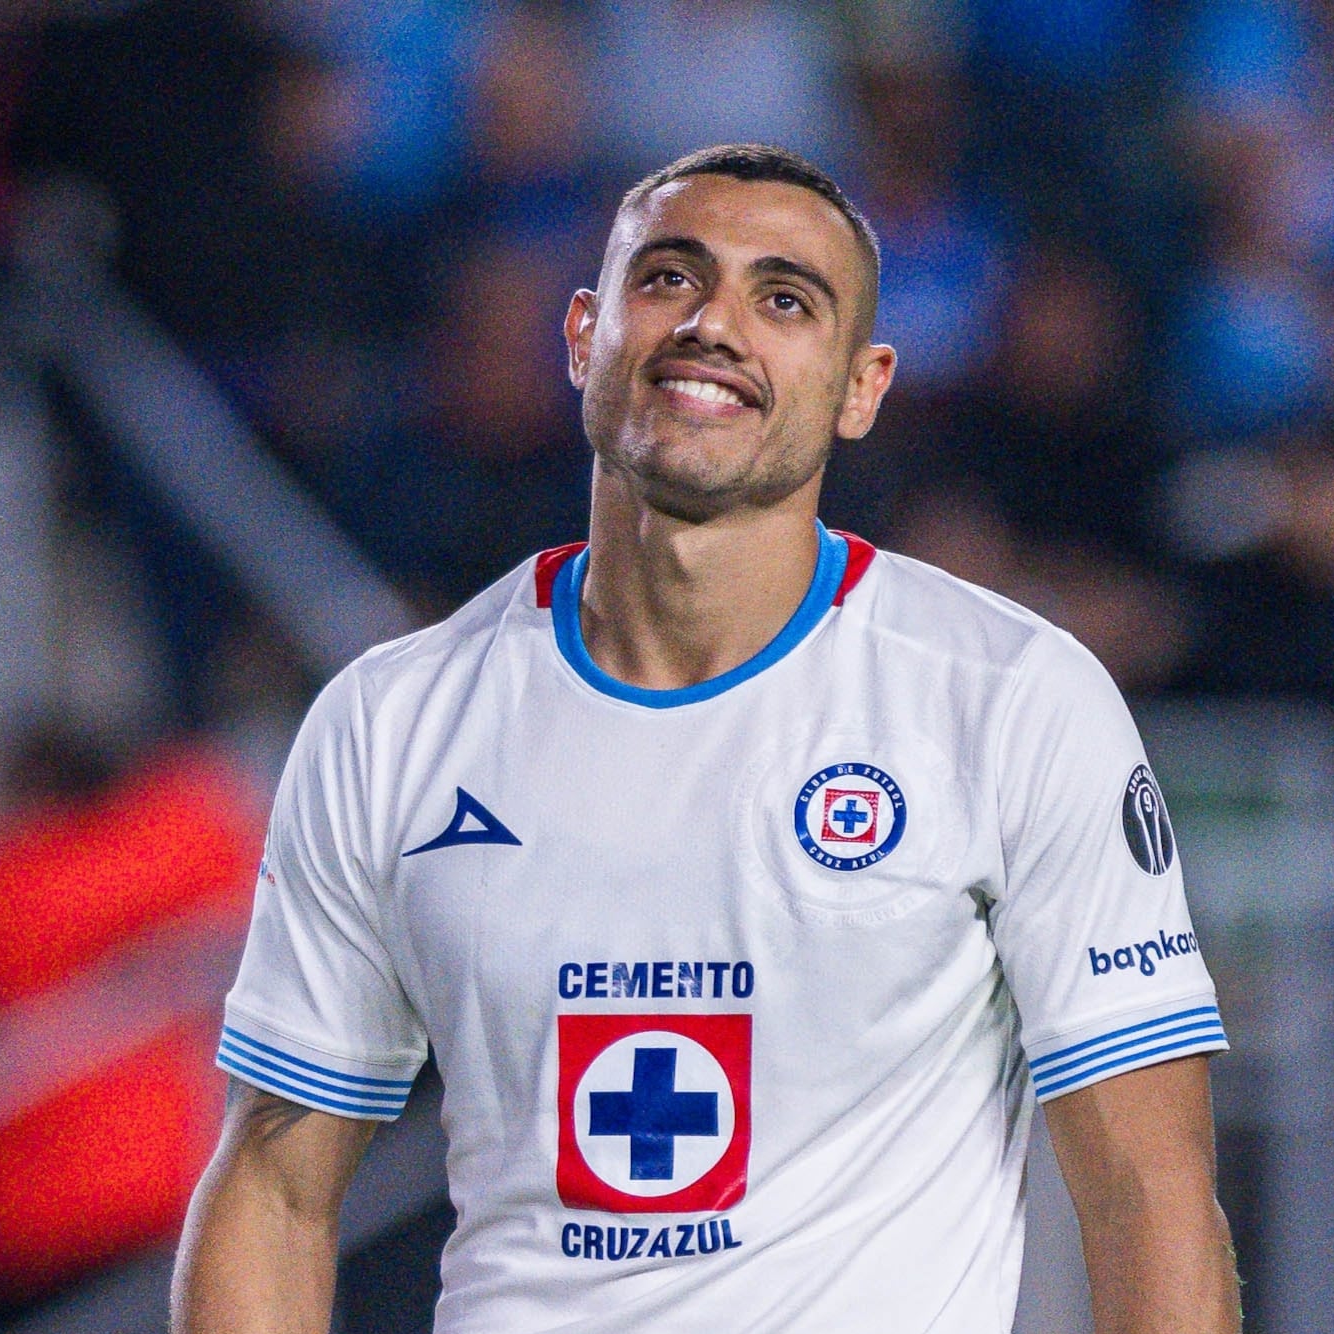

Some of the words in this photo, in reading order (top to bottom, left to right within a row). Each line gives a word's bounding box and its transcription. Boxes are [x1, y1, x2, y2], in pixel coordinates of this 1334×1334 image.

[800, 773, 828, 802] CLUB
[837, 765, 854, 774] DE
[864, 767, 903, 809] FUTBOL
[1143, 791, 1153, 812] 9
[809, 846, 842, 868] CRUZ
[852, 850, 885, 869] AZUL
[558, 961, 754, 998] CEMENTO
